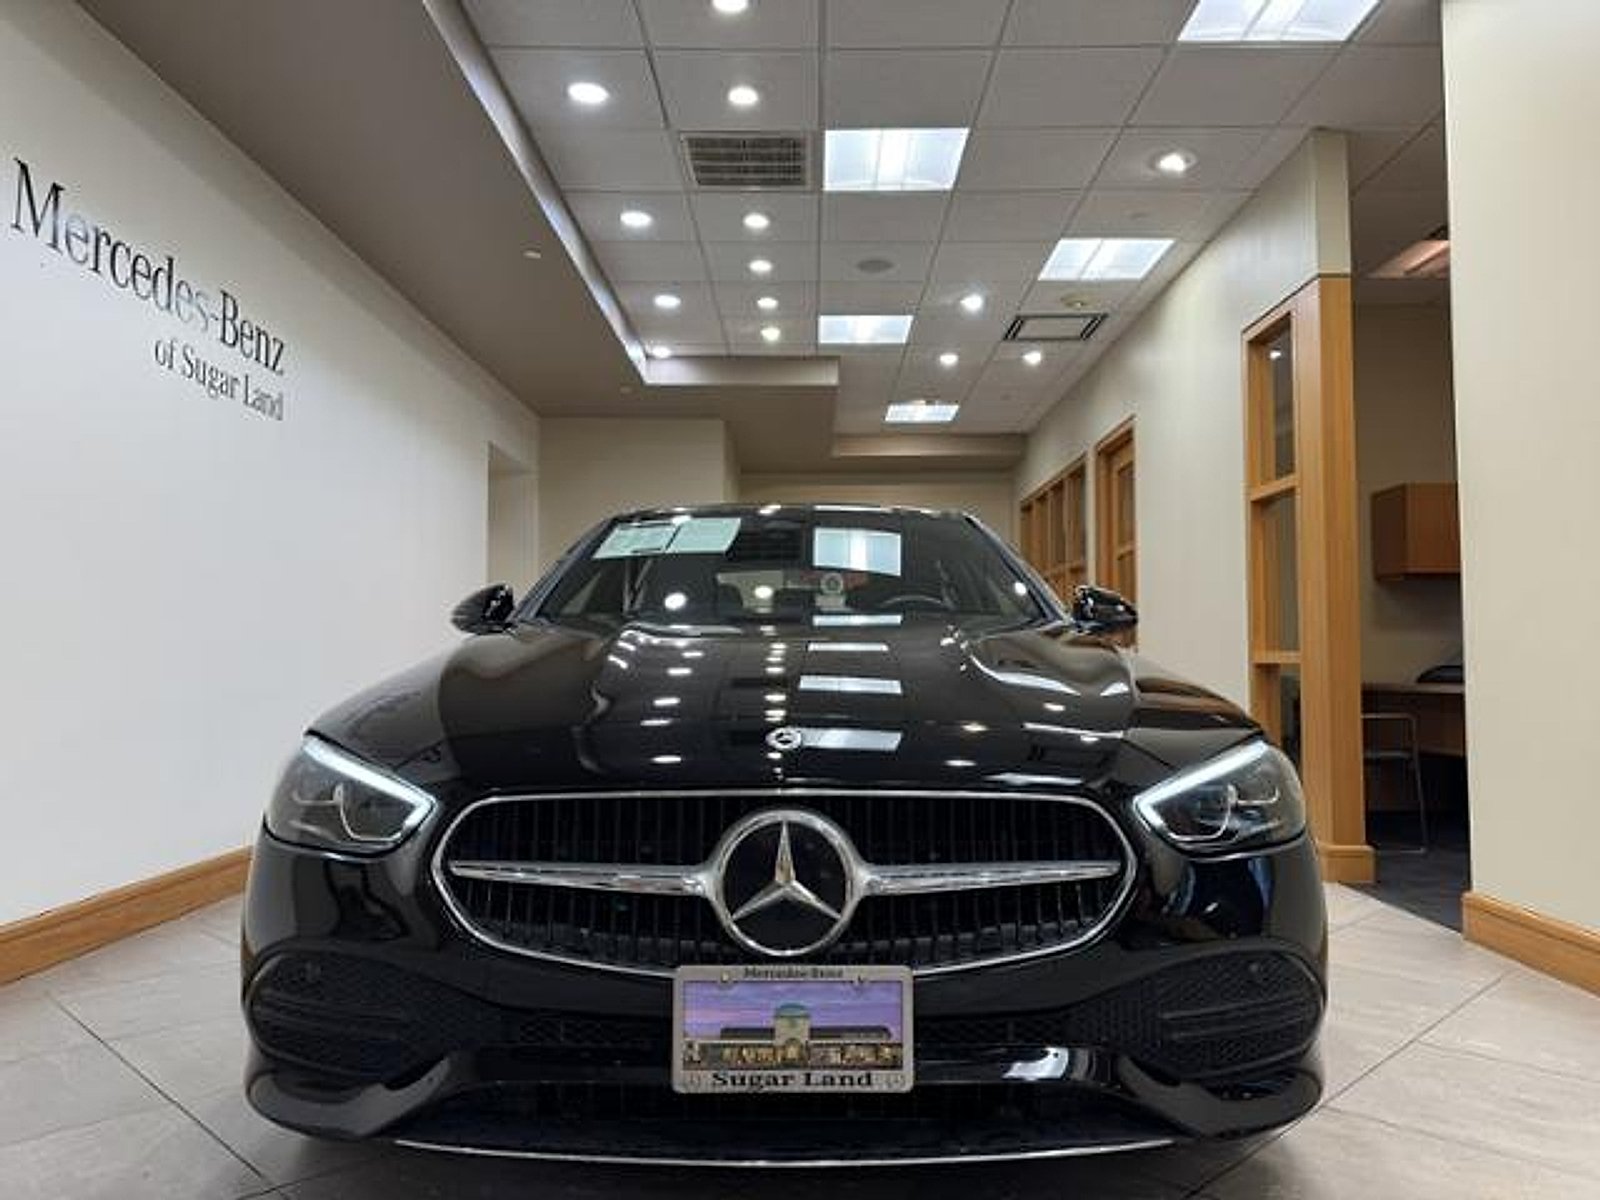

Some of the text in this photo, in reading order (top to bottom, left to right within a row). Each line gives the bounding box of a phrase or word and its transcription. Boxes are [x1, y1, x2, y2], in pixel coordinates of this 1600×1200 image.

[11, 157, 284, 375] Mercedes-Benz
[155, 339, 283, 421] of Sugar Land
[712, 1072, 872, 1090] Sugar Land
